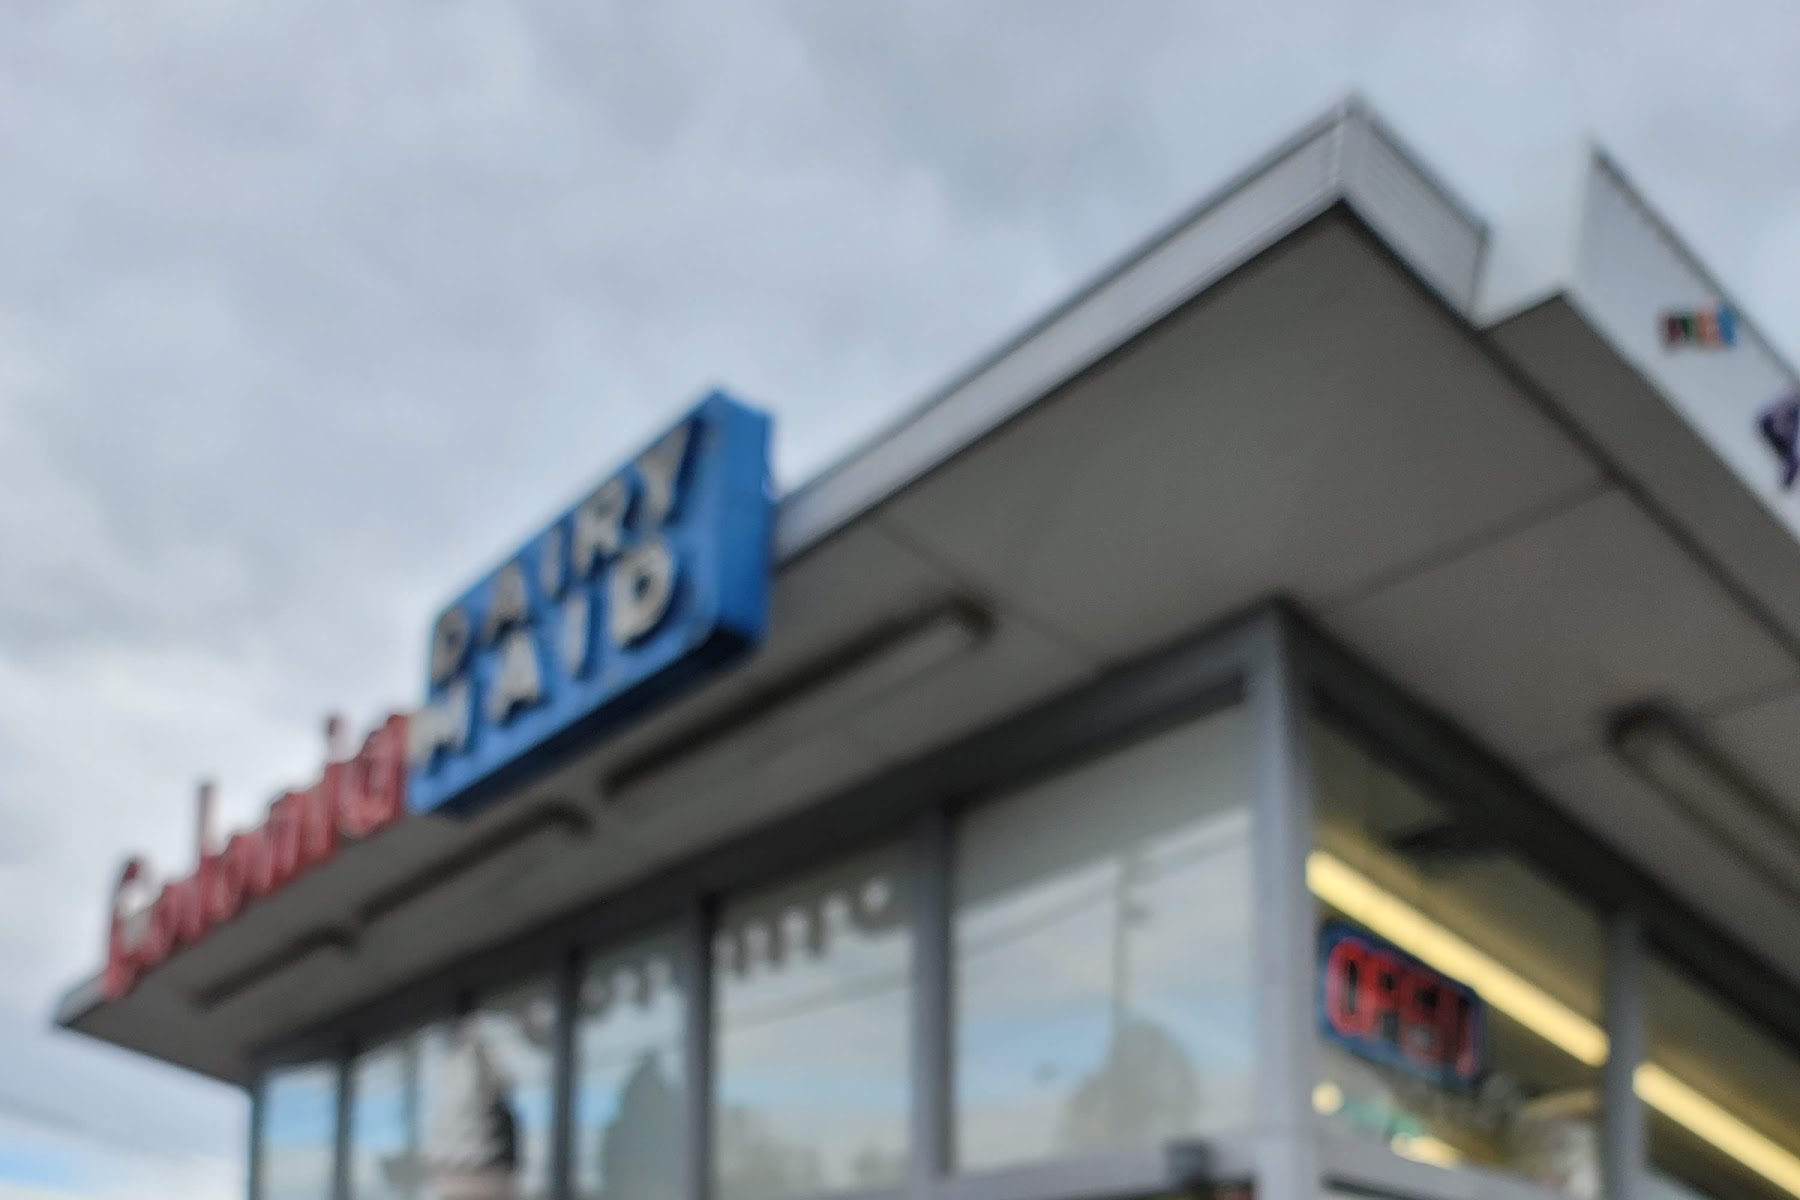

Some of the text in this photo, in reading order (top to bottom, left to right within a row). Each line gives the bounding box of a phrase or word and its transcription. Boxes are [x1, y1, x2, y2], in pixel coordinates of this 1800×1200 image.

[405, 538, 676, 768] MAID
[430, 416, 692, 686] DAIRY
[1326, 936, 1480, 1079] OPEN
